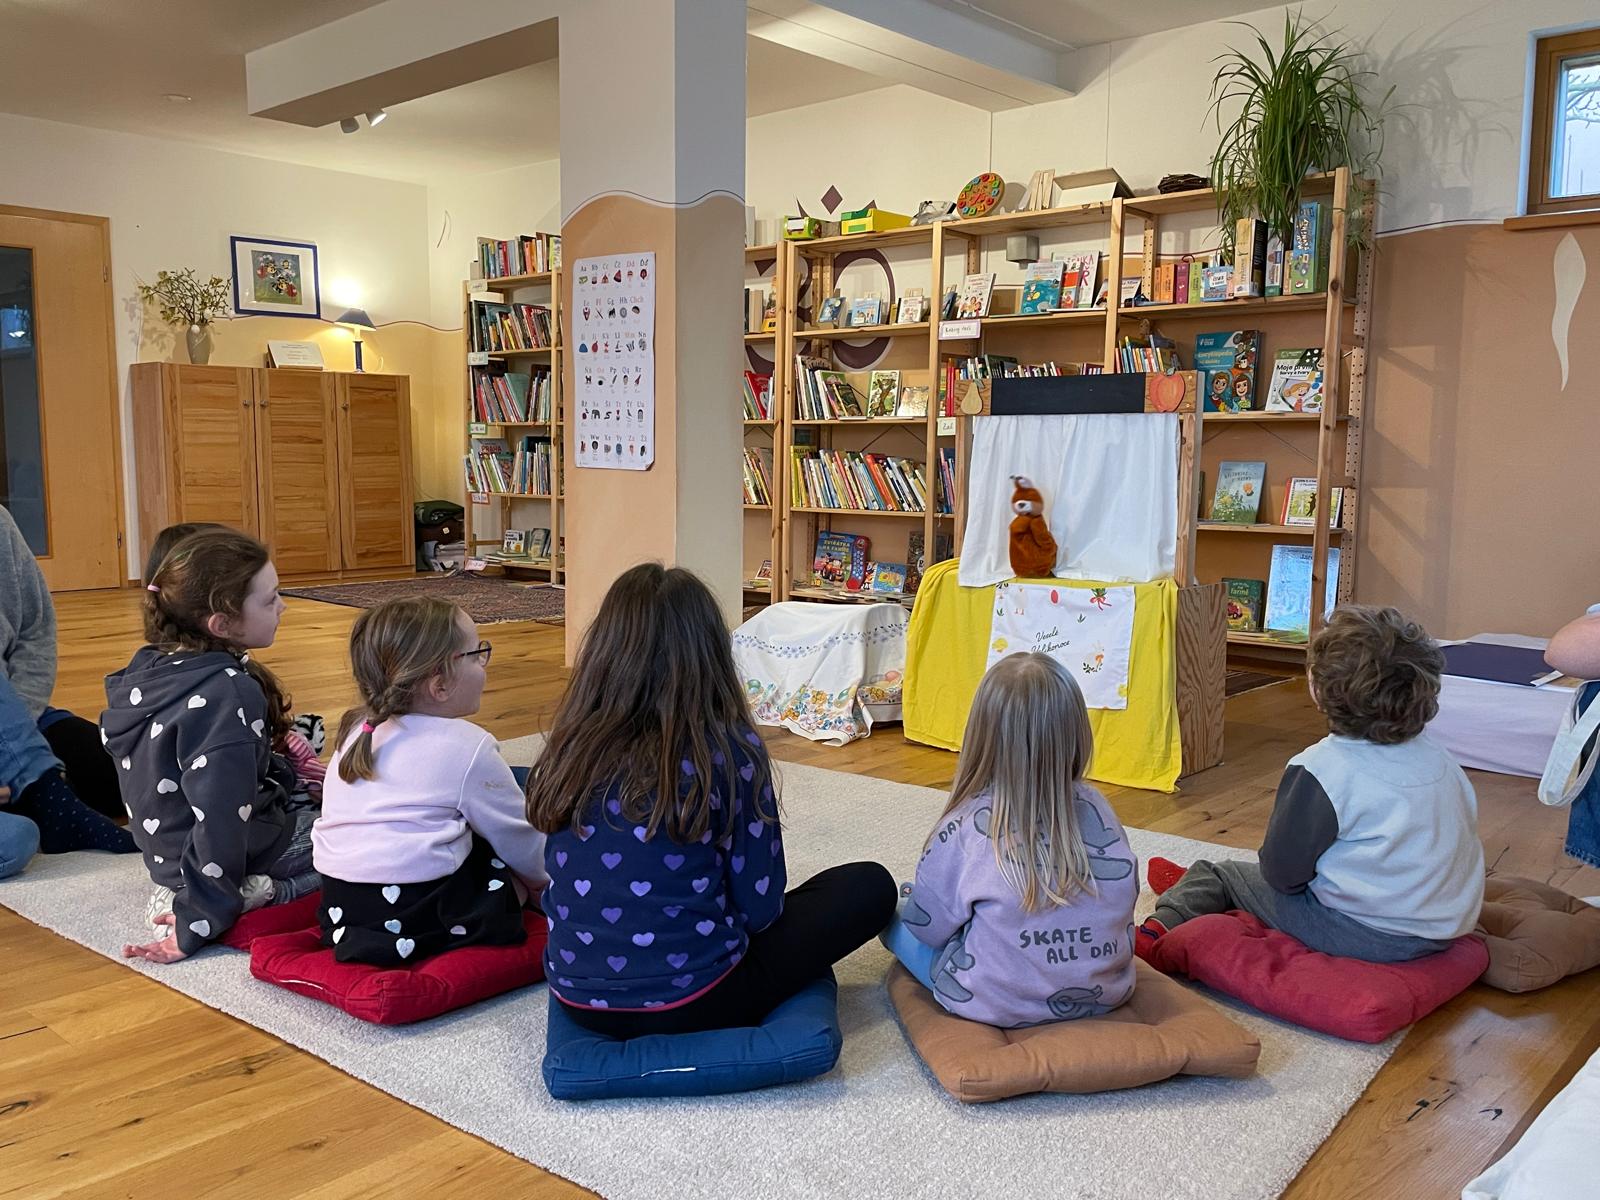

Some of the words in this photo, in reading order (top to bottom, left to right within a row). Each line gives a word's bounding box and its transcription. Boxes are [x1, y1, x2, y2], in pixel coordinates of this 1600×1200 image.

[938, 815, 963, 843] DAY
[1019, 926, 1093, 949] SKATE
[1046, 945, 1079, 965] ALL
[1090, 938, 1118, 959] DAY
